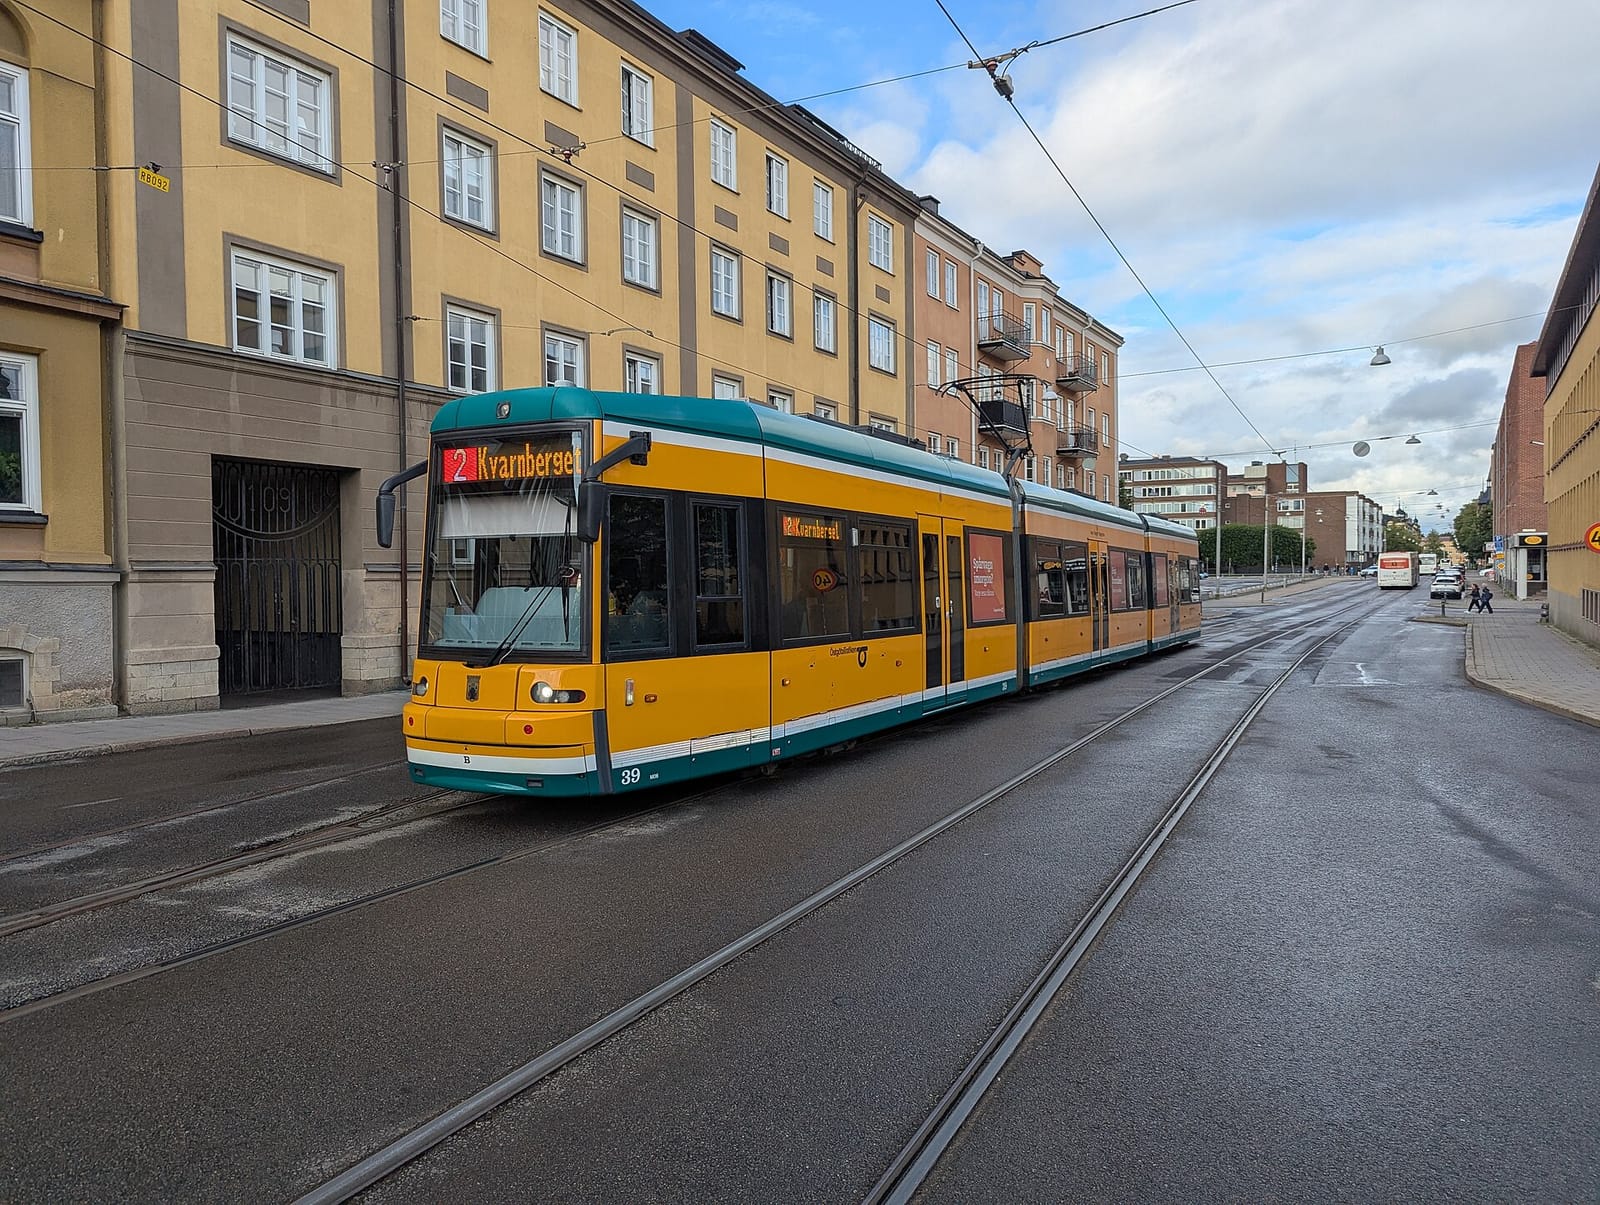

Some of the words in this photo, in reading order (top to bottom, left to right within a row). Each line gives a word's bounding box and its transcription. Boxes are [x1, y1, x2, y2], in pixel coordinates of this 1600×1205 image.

[140, 171, 168, 191] RB092
[453, 449, 467, 482] 2
[477, 443, 582, 481] Kvarnberget
[463, 755, 471, 764] B
[621, 768, 641, 785] 39
